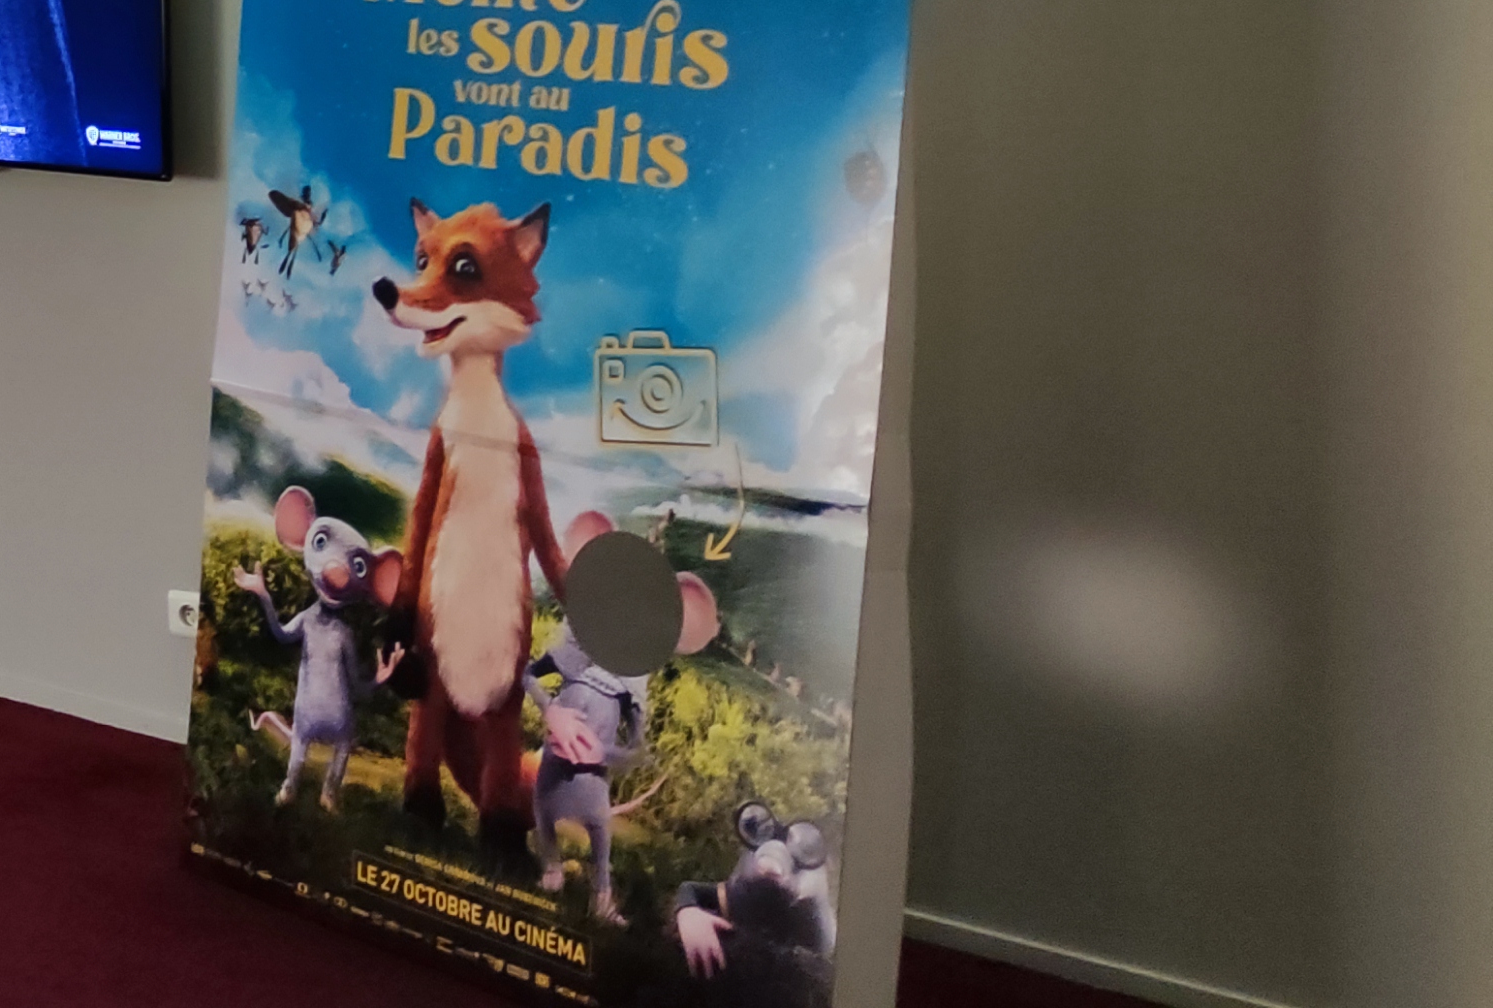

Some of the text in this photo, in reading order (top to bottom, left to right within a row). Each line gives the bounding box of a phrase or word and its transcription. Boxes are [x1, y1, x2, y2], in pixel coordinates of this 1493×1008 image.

[407, 18, 460, 58] les
[454, 79, 571, 113] vont au
[387, 87, 690, 191] Paradis
[357, 861, 378, 886] LE
[381, 870, 401, 894] 27
[403, 879, 484, 927] OCTOBRE
[485, 909, 511, 936] AU
[514, 920, 586, 967] CINÉMA
